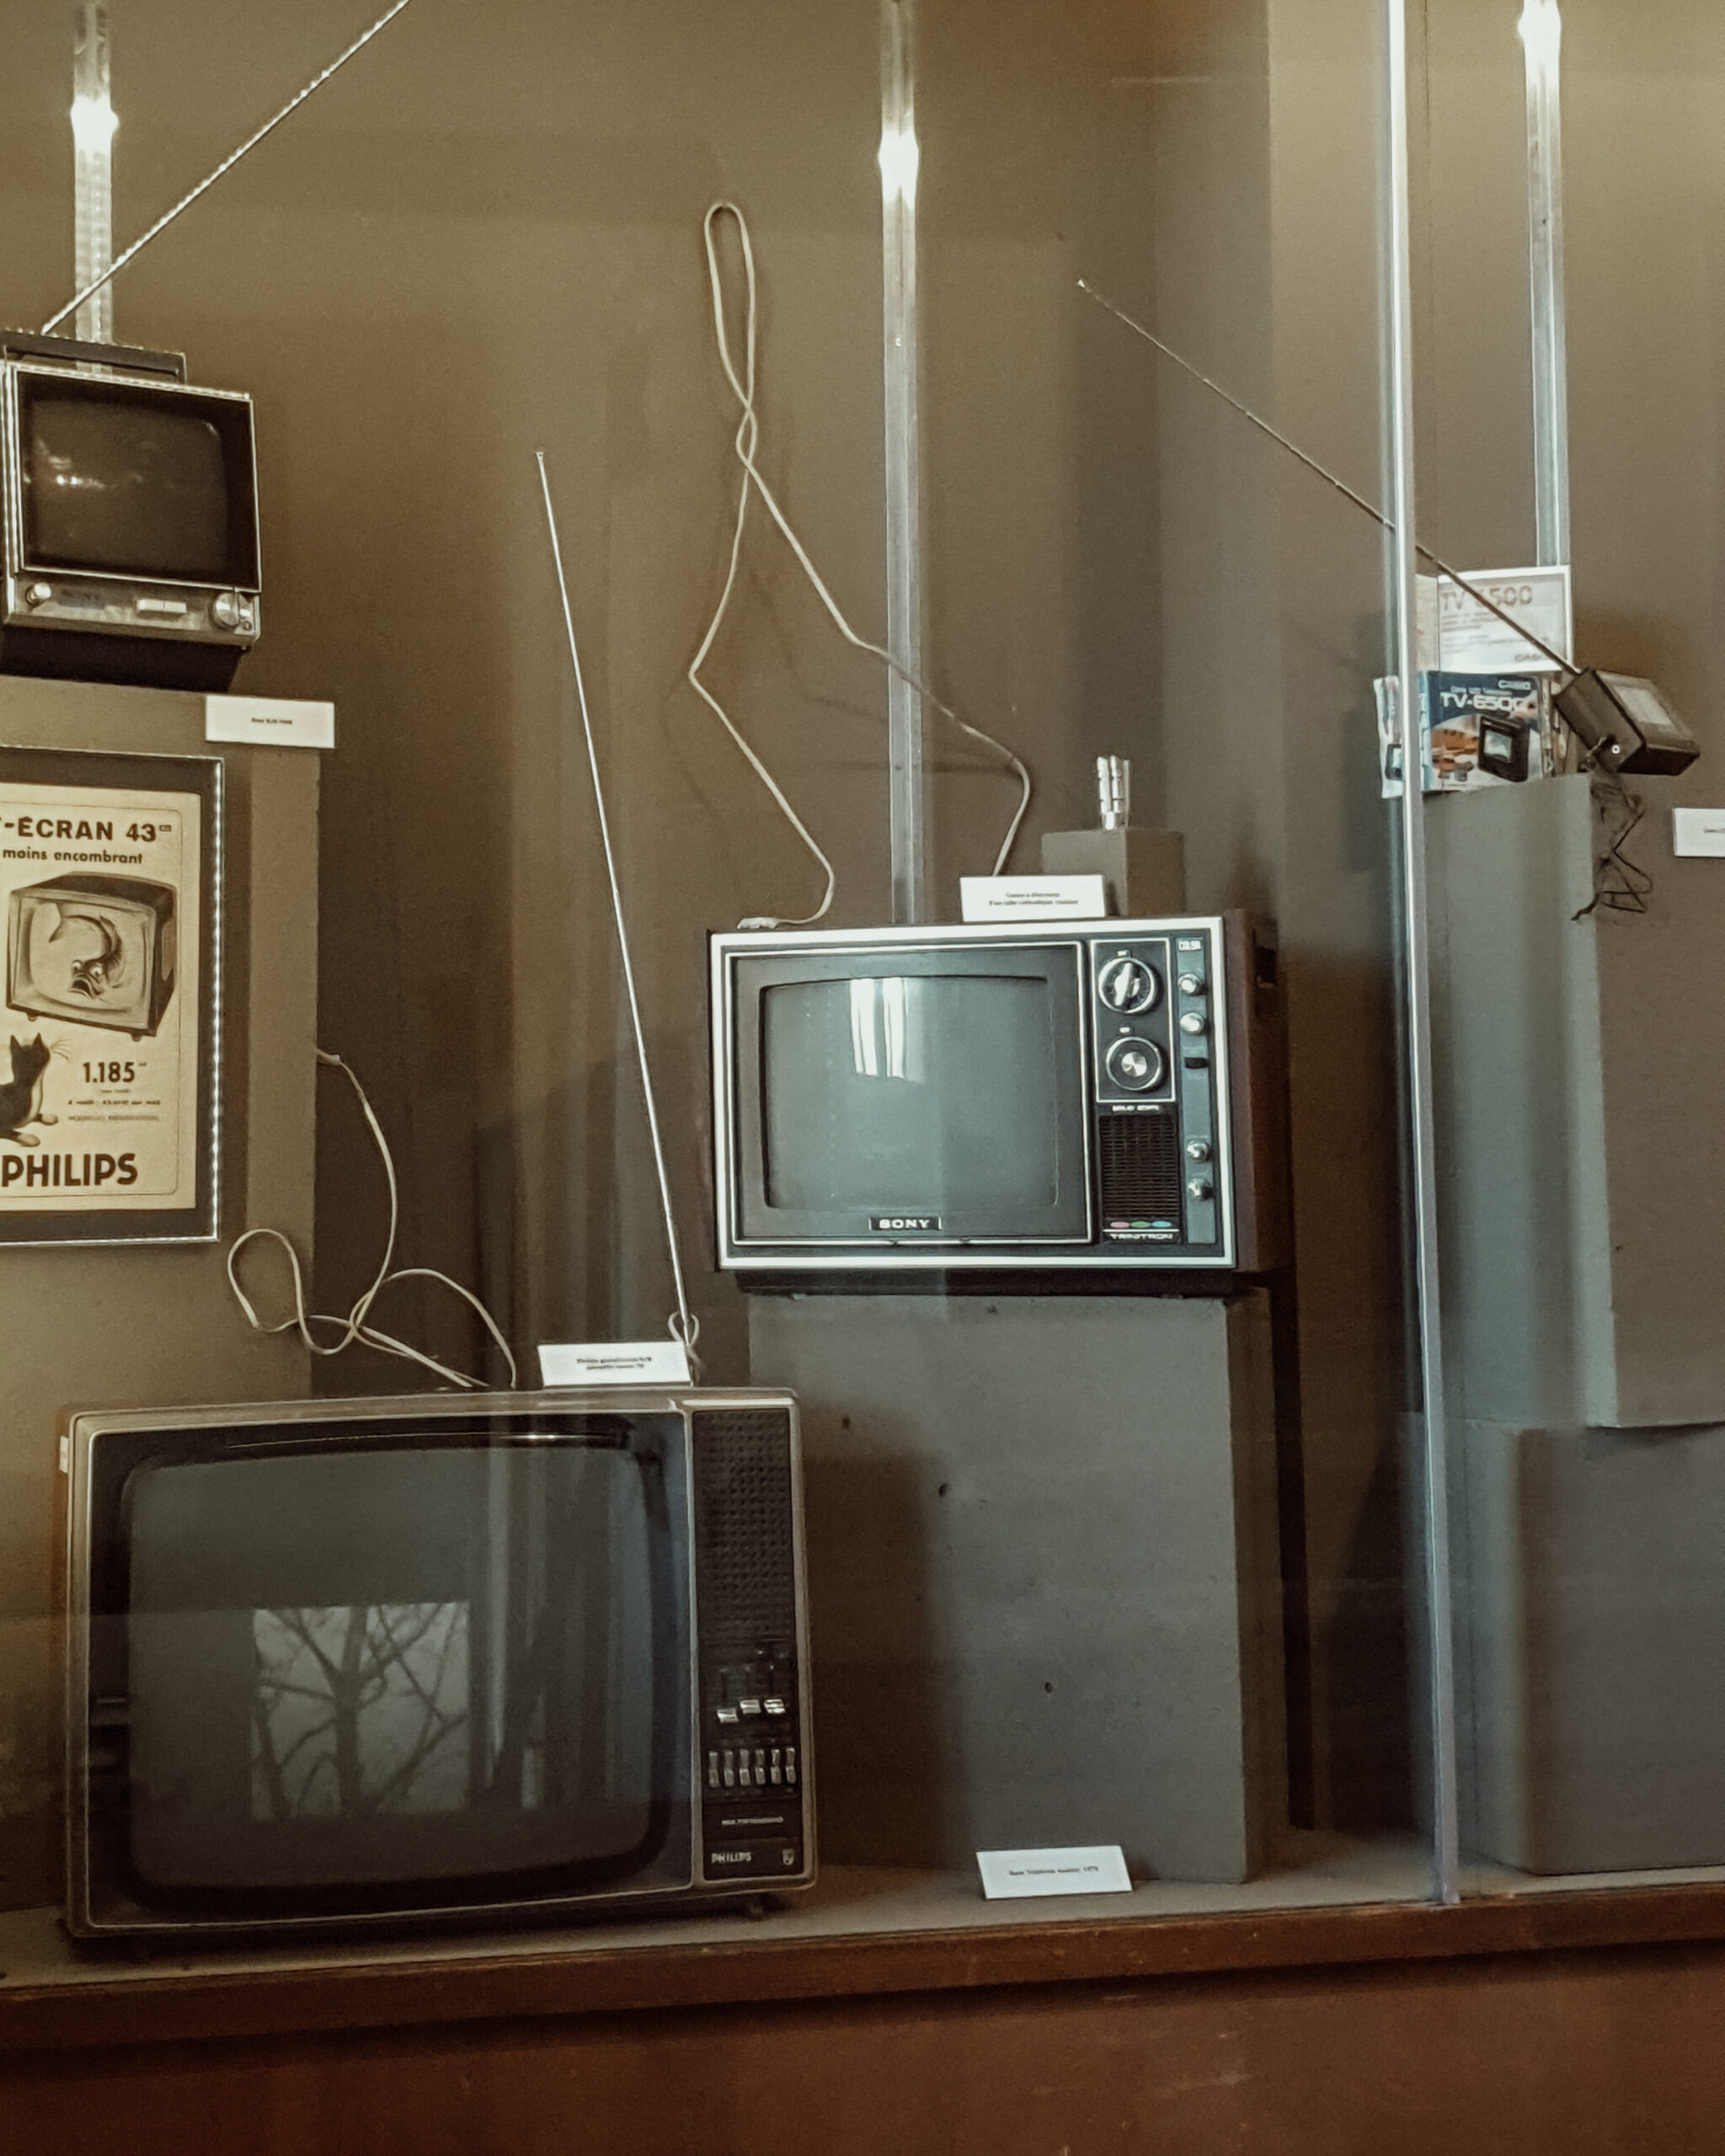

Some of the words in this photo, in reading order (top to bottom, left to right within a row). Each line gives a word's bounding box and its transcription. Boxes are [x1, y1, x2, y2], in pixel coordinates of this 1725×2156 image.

[3, 846, 47, 860] moins
[54, 850, 142, 864] encombrant
[83, 1061, 136, 1083] 1.185
[2, 1153, 138, 1187] PHILIPS
[879, 1219, 930, 1229] SONY
